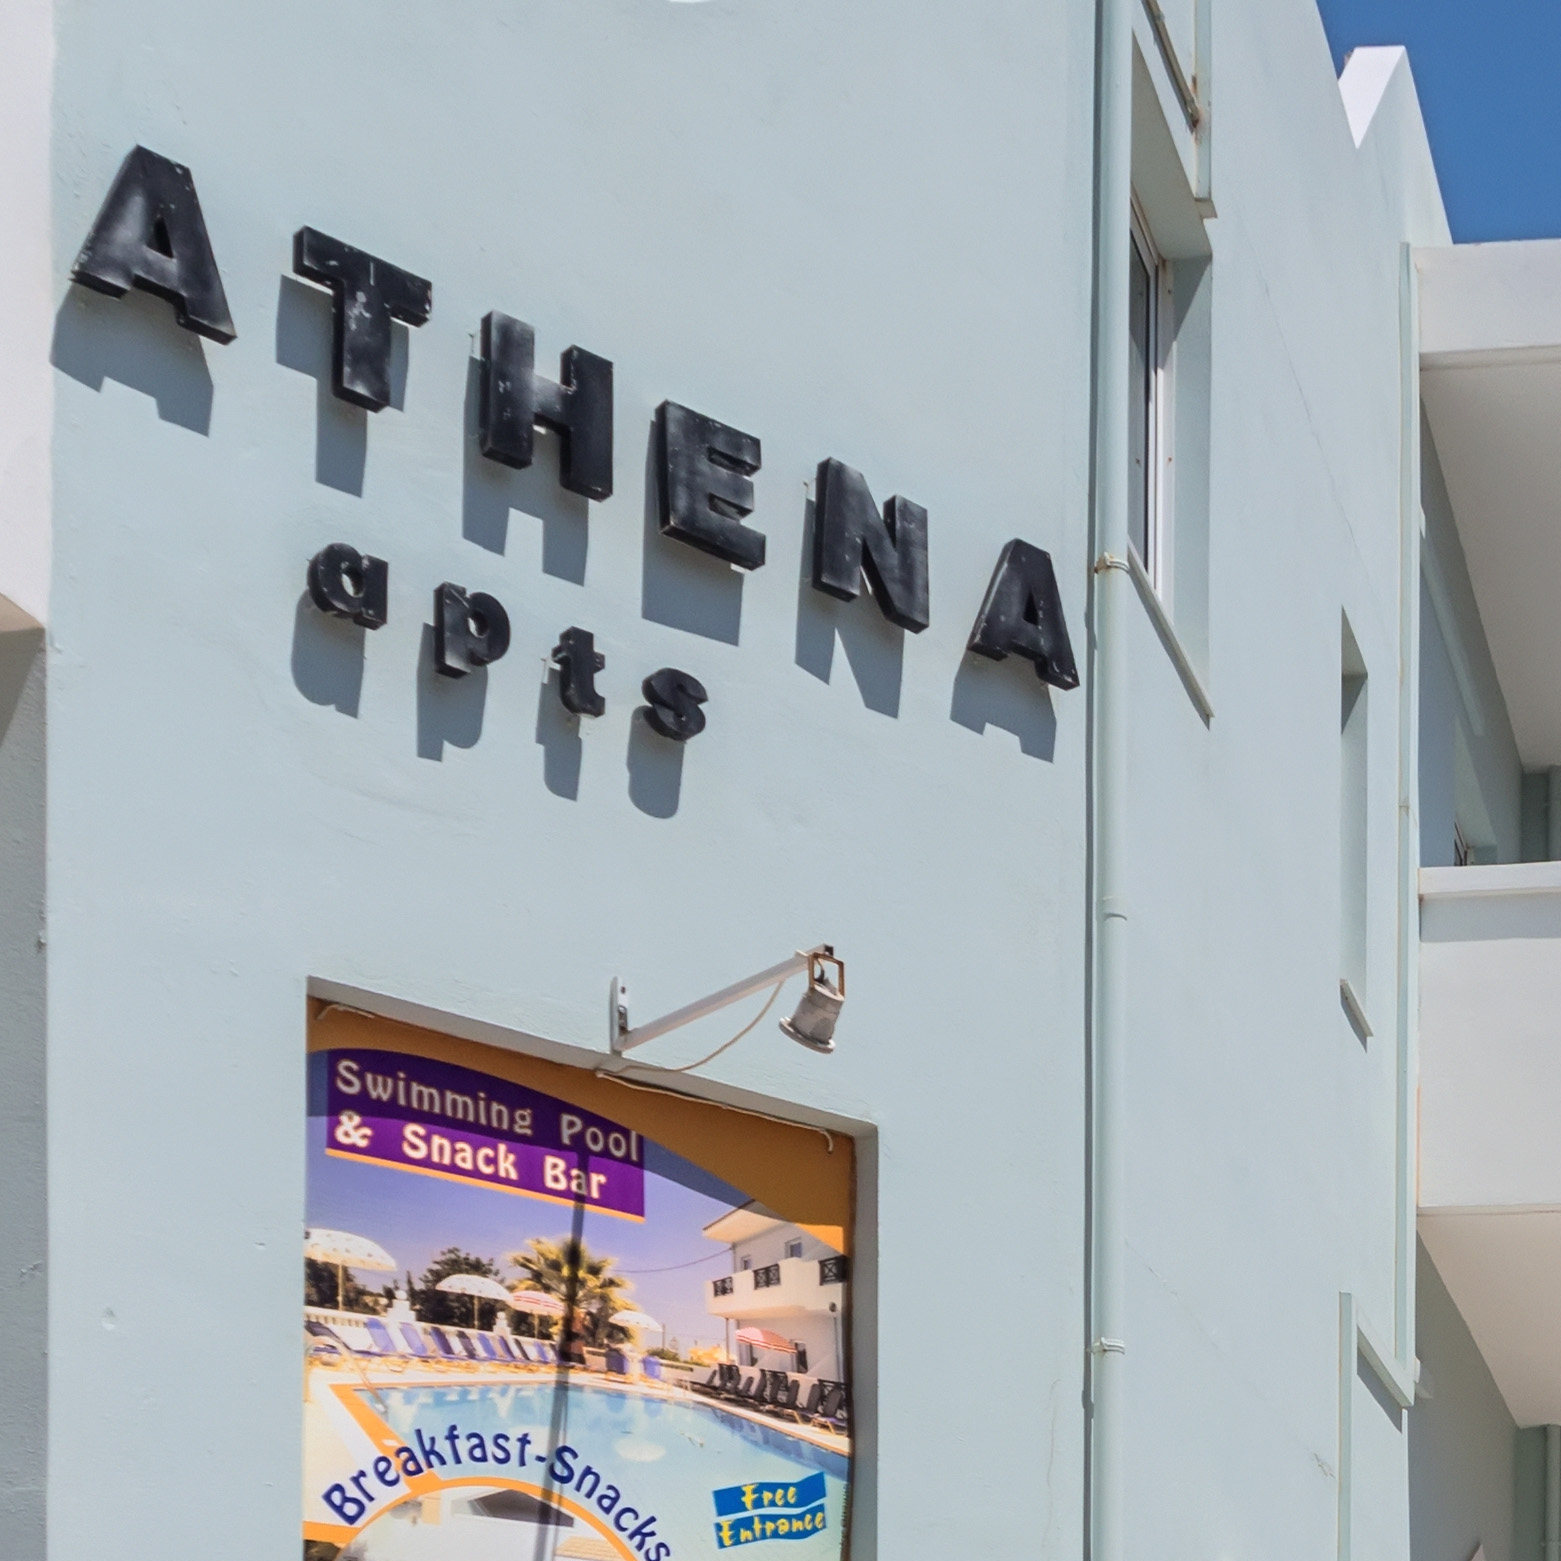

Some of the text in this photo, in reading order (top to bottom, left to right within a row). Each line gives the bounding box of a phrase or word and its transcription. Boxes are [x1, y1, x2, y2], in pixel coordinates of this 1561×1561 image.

[71, 144, 1080, 690] ATHENA
[307, 543, 709, 742] apts
[334, 1110, 606, 1199] & Snack Bar
[335, 1059, 638, 1161] Swimming Pool
[719, 1511, 824, 1547] Entrance
[741, 1483, 797, 1511] Free
